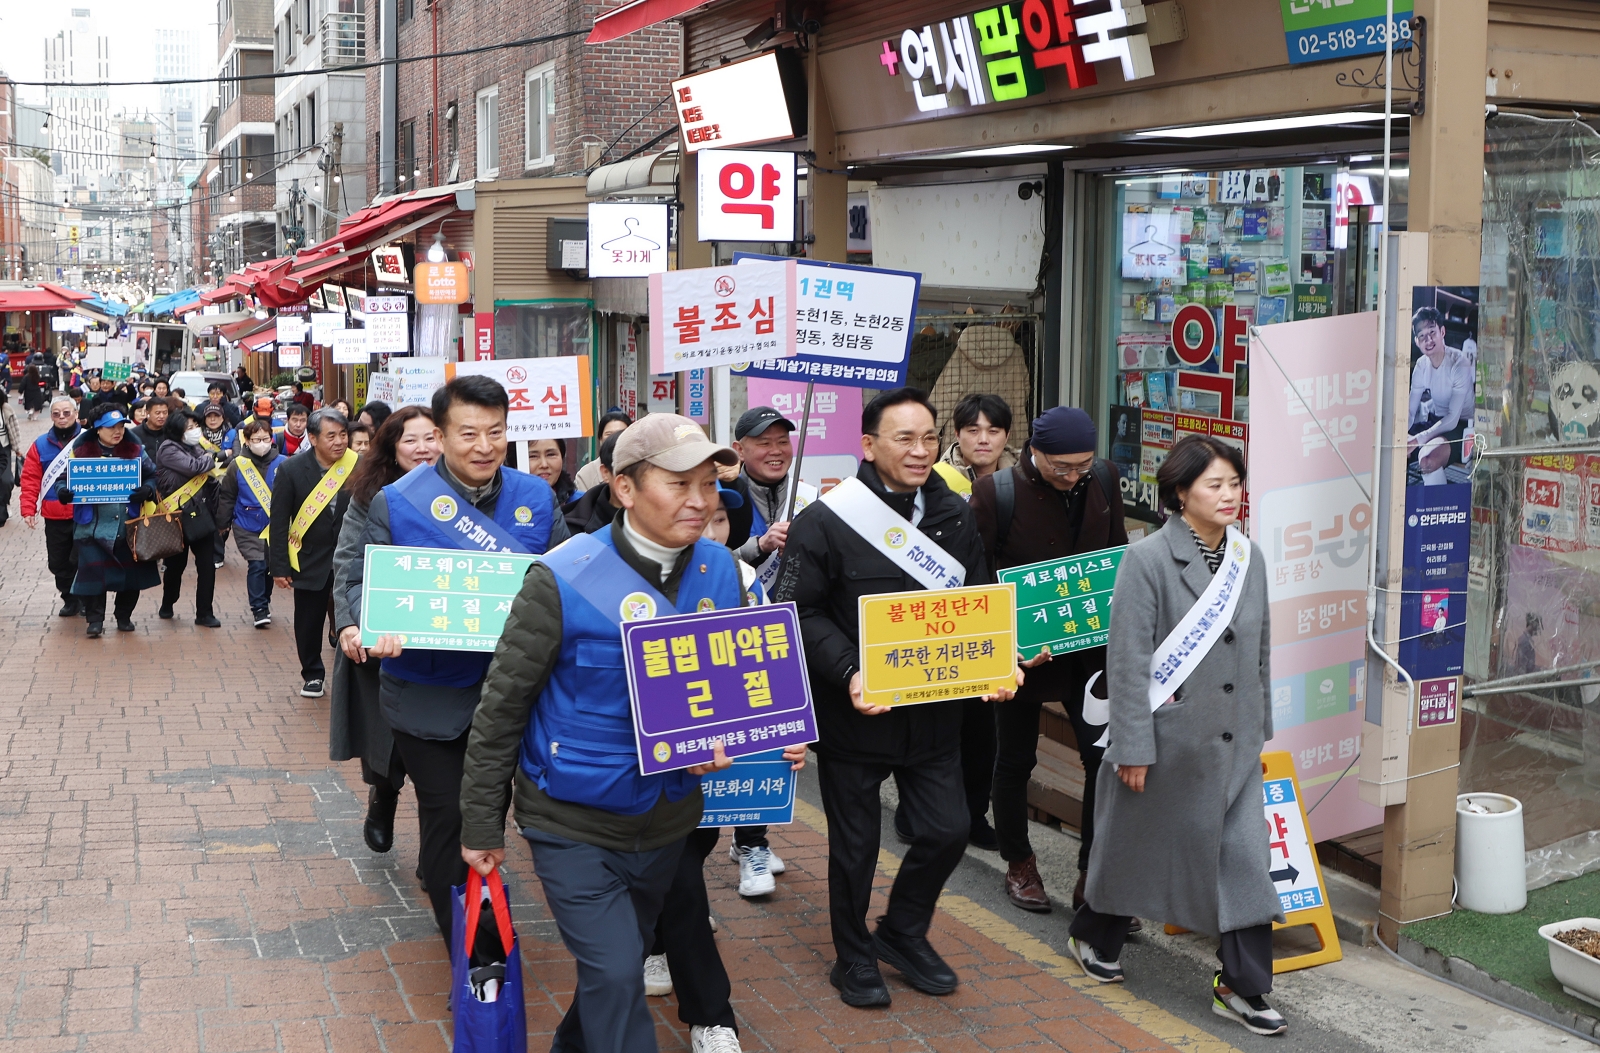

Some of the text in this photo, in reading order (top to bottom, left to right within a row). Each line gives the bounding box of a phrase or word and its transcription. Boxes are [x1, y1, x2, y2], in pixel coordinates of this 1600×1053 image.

[899, 0, 1134, 112] 연세팜약국
[718, 163, 780, 229] 약
[612, 250, 651, 263] 옷가게
[428, 278, 456, 287] Lotto
[800, 277, 855, 301] 1권역
[672, 295, 775, 345] 불조심
[854, 312, 905, 333] 논현2동
[832, 332, 874, 351] 청담동
[753, 358, 898, 383] 바르게살기운동강남구협의회
[1170, 302, 1248, 420] 약
[690, 368, 705, 417] 화장품
[771, 391, 838, 415] 연세팜
[1177, 417, 1208, 431] 프로폴리스
[1232, 425, 1244, 437] 건강
[1420, 512, 1467, 527] 안티푸라민
[454, 515, 498, 551] 강남구
[394, 555, 516, 576] 제로웨이스트
[907, 545, 946, 580] 강남구
[1021, 557, 1115, 586] 제로웨이스트
[886, 594, 990, 623] 불법전단지
[925, 620, 956, 636] NO
[411, 636, 463, 647] 바르게살기운동
[642, 622, 790, 678] 불법 마약류
[885, 638, 995, 668] 깨끗한 거리문화
[924, 665, 959, 682] YES
[906, 683, 990, 700] 바르게살기운동 강남구협의회
[749, 719, 806, 742] 강남구협의회
[758, 777, 786, 795] 시작
[717, 812, 761, 823] 강남구협의회
[1280, 891, 1316, 910] 팜약국
